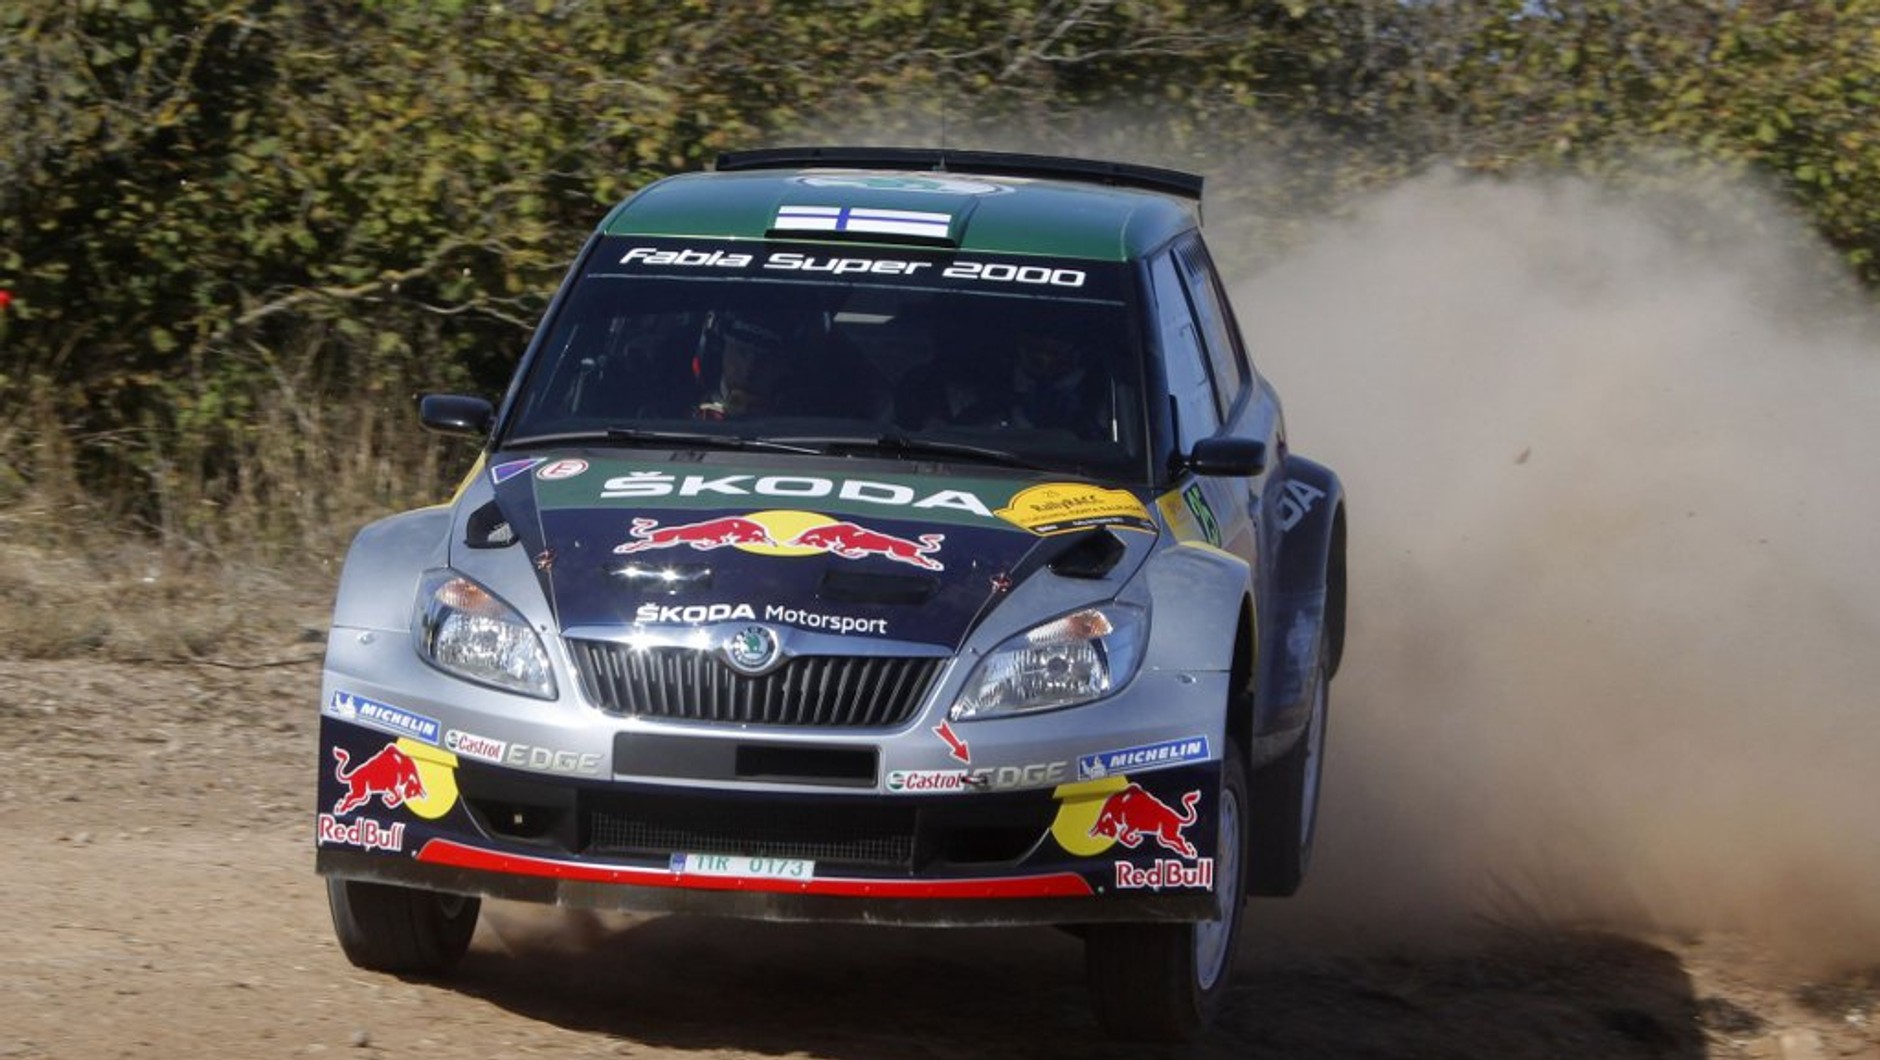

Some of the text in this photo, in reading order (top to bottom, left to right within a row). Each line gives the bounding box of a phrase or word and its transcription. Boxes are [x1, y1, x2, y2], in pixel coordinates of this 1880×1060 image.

[619, 246, 1087, 289] Fabia Super 2000
[600, 471, 994, 517] ŠKODA
[635, 602, 888, 635] ŠKODA Motorsport
[359, 702, 437, 737] MICHELIN
[458, 734, 603, 775] Castrol EDGE
[1109, 741, 1202, 768] MICHELIN
[904, 771, 964, 791] Castrol
[318, 815, 405, 850] Red Bull
[1115, 859, 1213, 888] Red Bull
